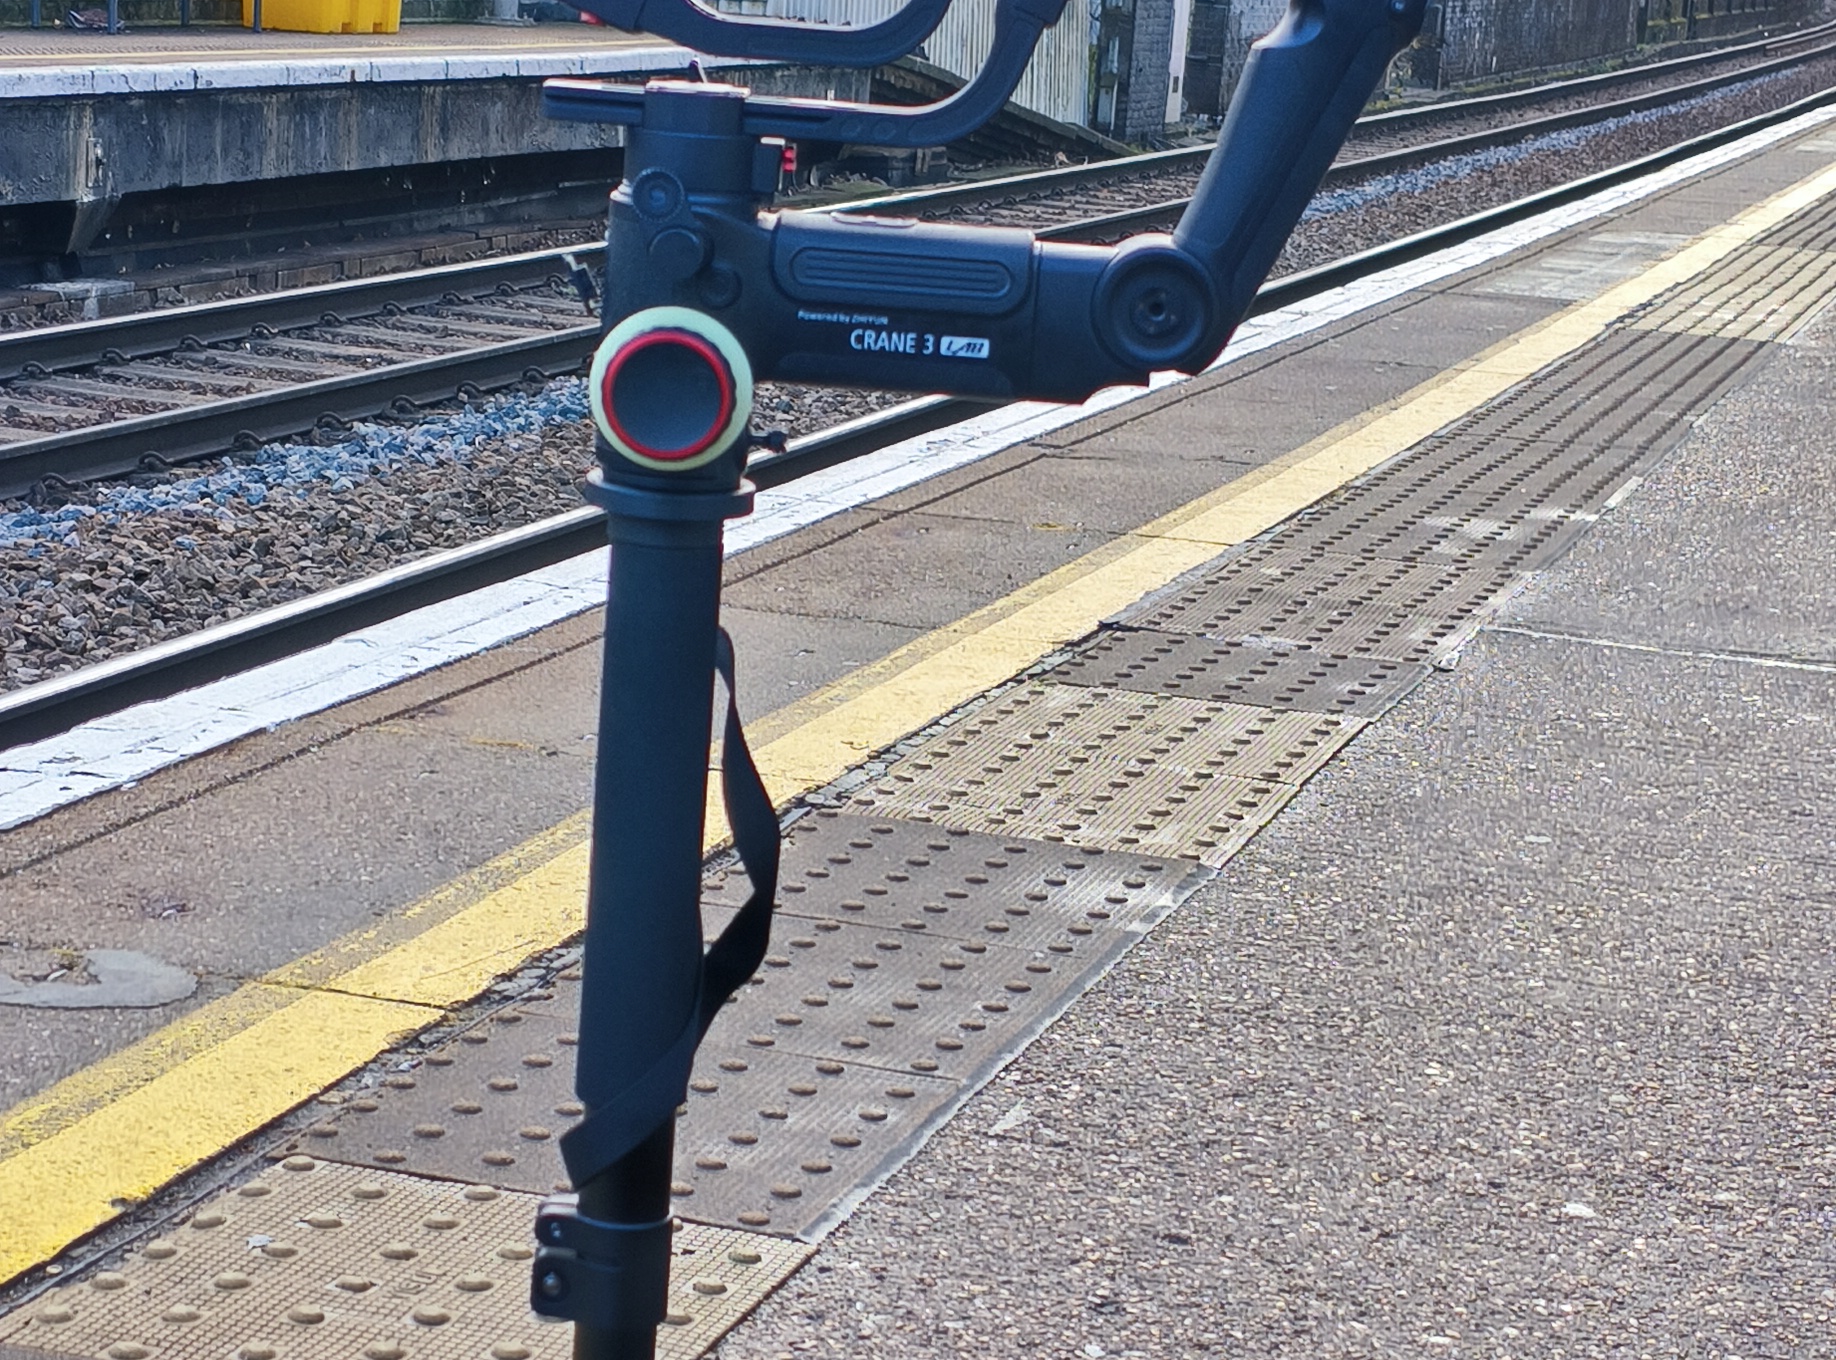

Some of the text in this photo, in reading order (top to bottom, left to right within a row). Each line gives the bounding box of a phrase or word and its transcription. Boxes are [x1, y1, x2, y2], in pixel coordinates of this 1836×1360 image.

[798, 310, 838, 322] Powered
[850, 328, 918, 354] CRANE
[922, 333, 935, 355] 3
